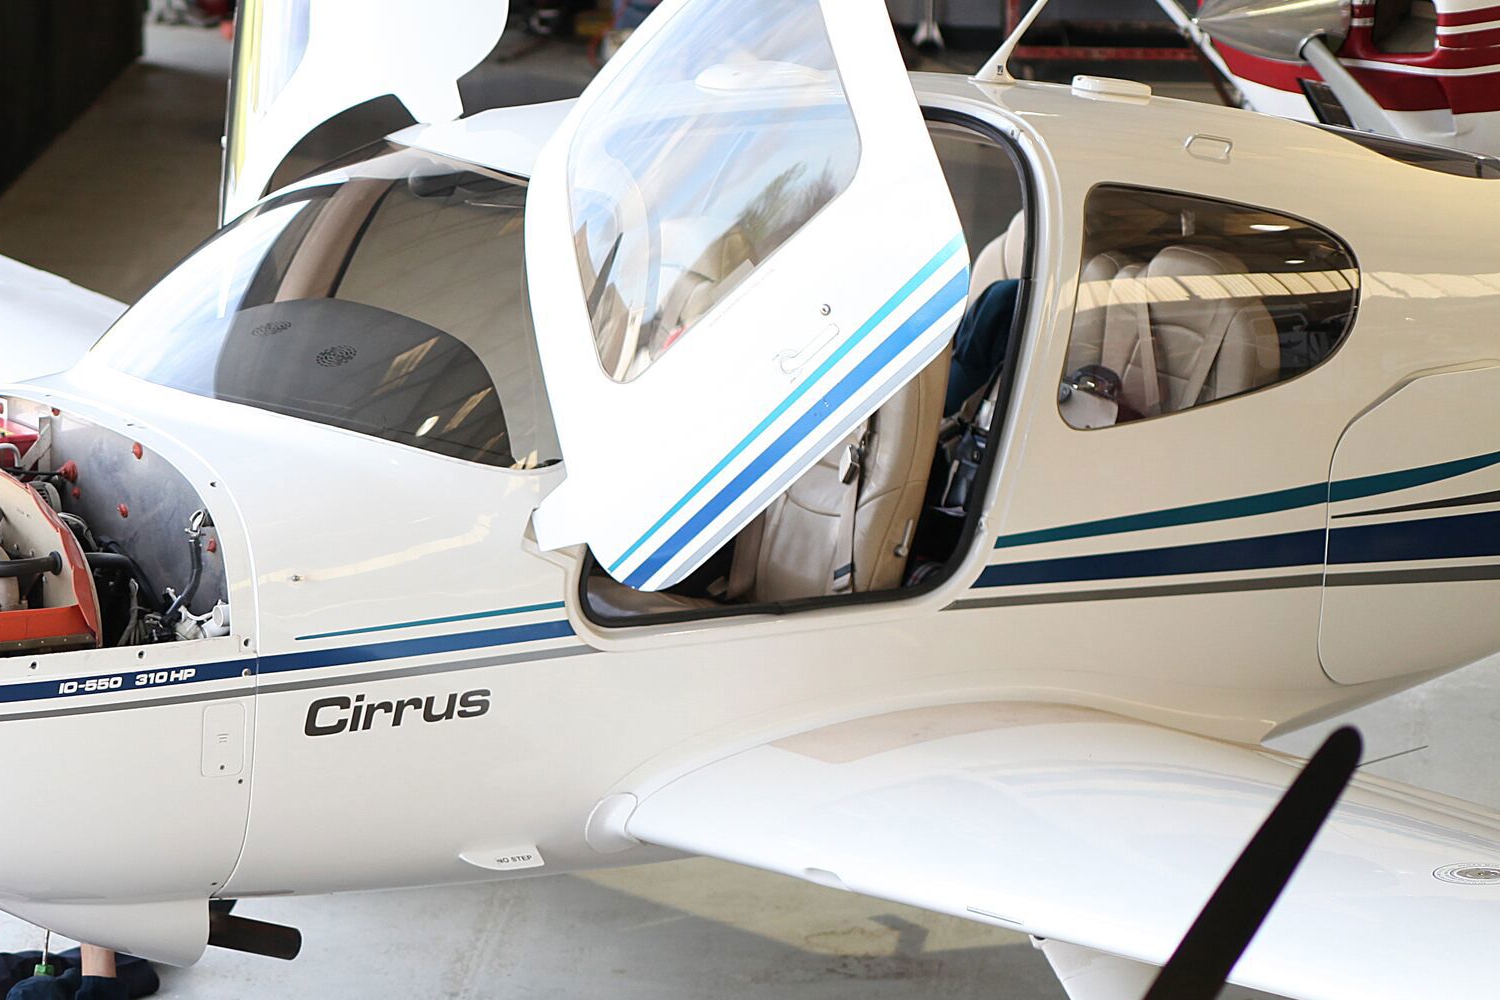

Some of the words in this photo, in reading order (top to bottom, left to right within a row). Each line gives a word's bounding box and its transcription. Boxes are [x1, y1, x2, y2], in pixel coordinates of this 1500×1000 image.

[134, 671, 168, 686] 310
[169, 668, 196, 682] HP
[304, 688, 491, 737] Cirrus
[496, 856, 510, 864] NO
[510, 854, 532, 863] STEP
